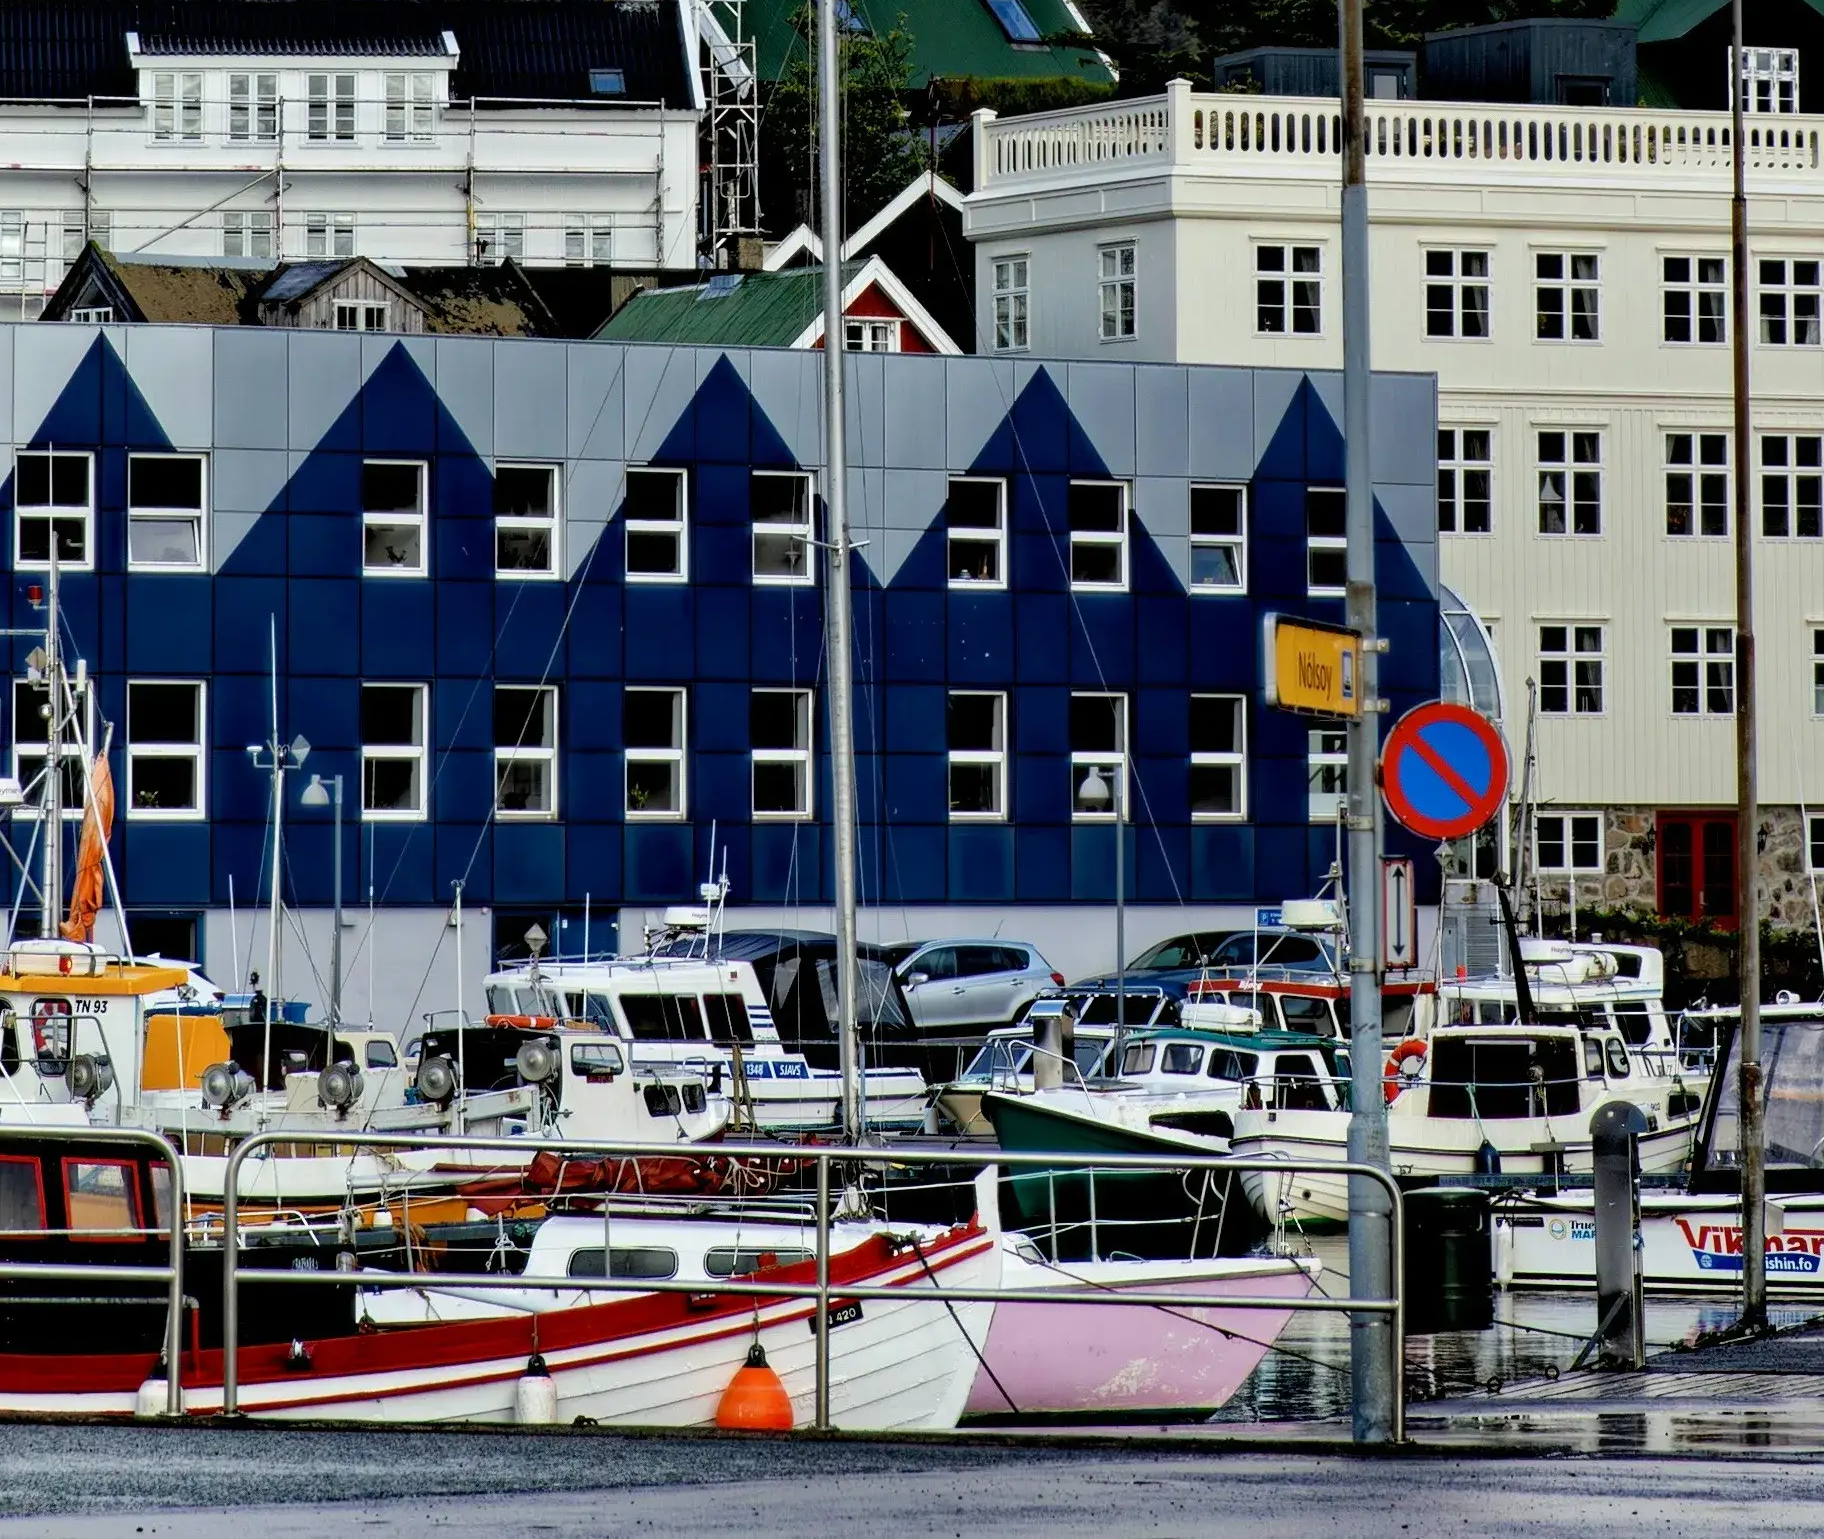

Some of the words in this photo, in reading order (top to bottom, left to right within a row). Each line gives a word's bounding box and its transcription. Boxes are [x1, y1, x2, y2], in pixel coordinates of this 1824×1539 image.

[1298, 652, 1333, 702] Nólsoy
[76, 999, 91, 1012] TN
[93, 1000, 107, 1013] 93
[1764, 1256, 1813, 1271] ishin.fo
[837, 1307, 856, 1321] 420
